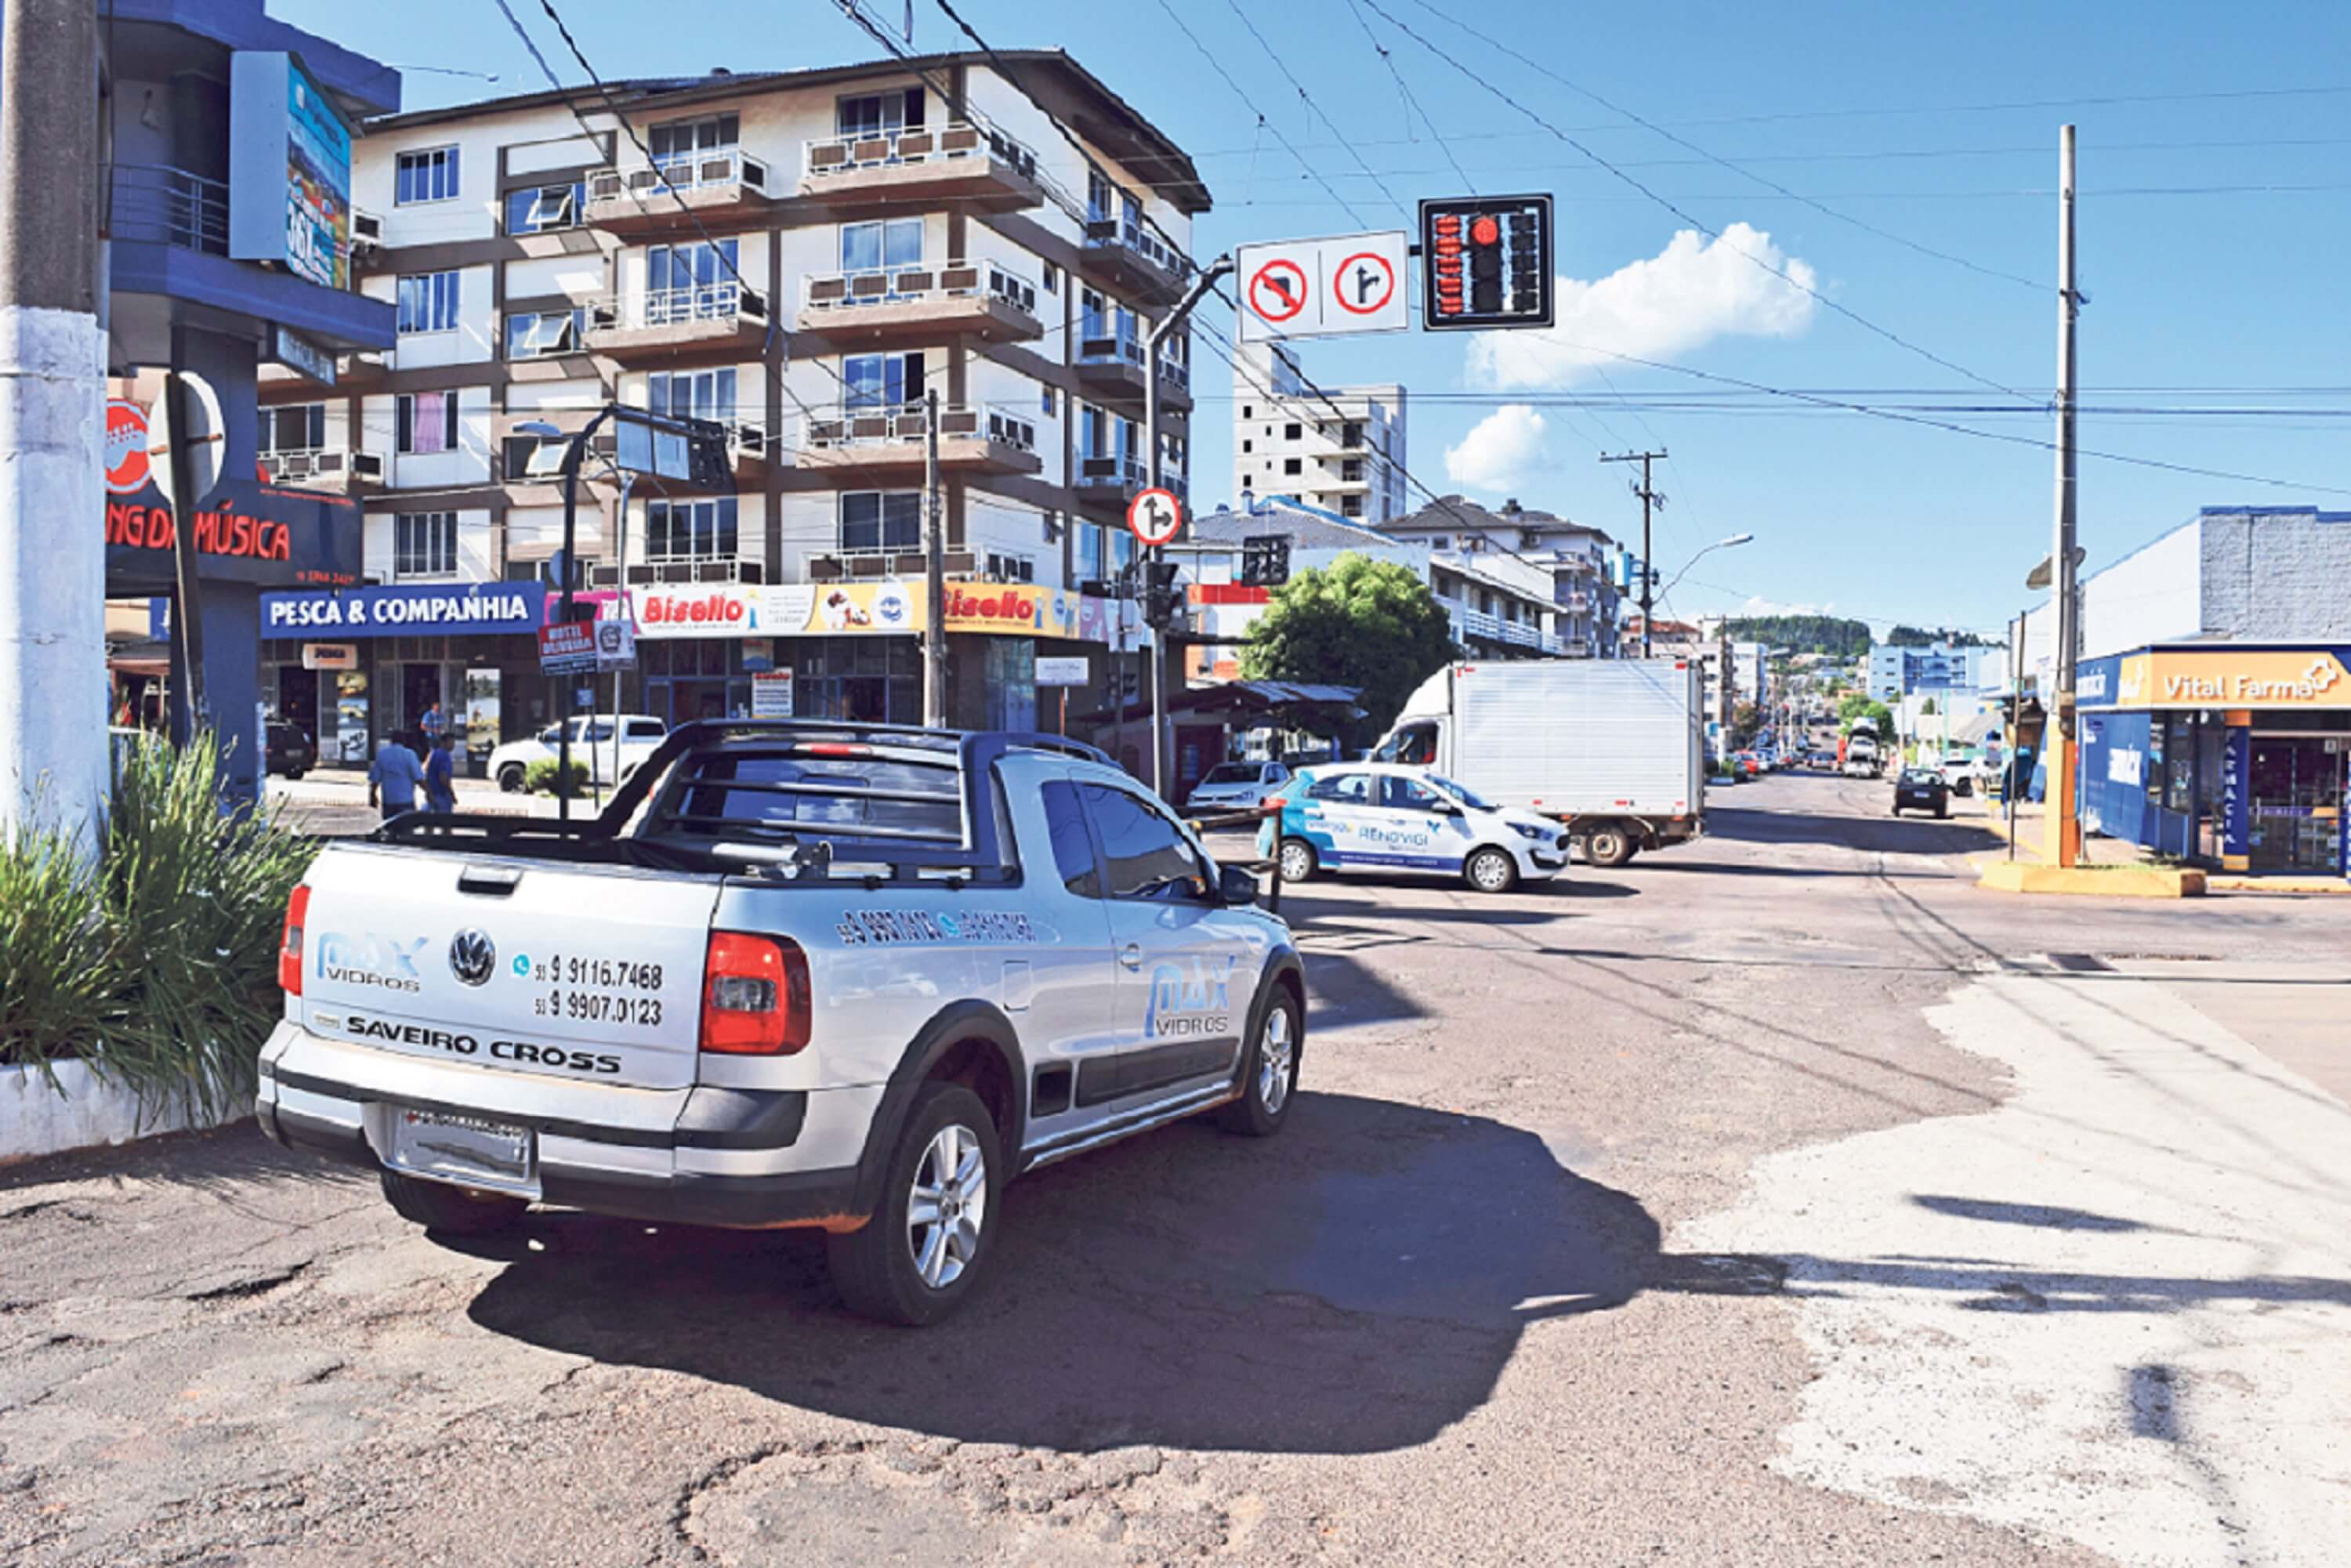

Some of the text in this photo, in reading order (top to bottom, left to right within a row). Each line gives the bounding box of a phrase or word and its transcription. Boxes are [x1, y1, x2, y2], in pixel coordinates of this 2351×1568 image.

[194, 499, 290, 560] MÚSICA
[270, 595, 528, 625] PESCA & COMPANHIA
[2164, 675, 2225, 698] Vital
[2236, 676, 2313, 699] Farma
[326, 966, 421, 994] VIDROS
[551, 953, 560, 983] 9
[567, 955, 663, 990] 9116.7468
[550, 989, 560, 1016] 9
[567, 990, 662, 1027] 9907.0123
[1155, 1016, 1229, 1036] VIDROS
[346, 1016, 478, 1055] SAVEIRO
[489, 1041, 621, 1074] CROSS
